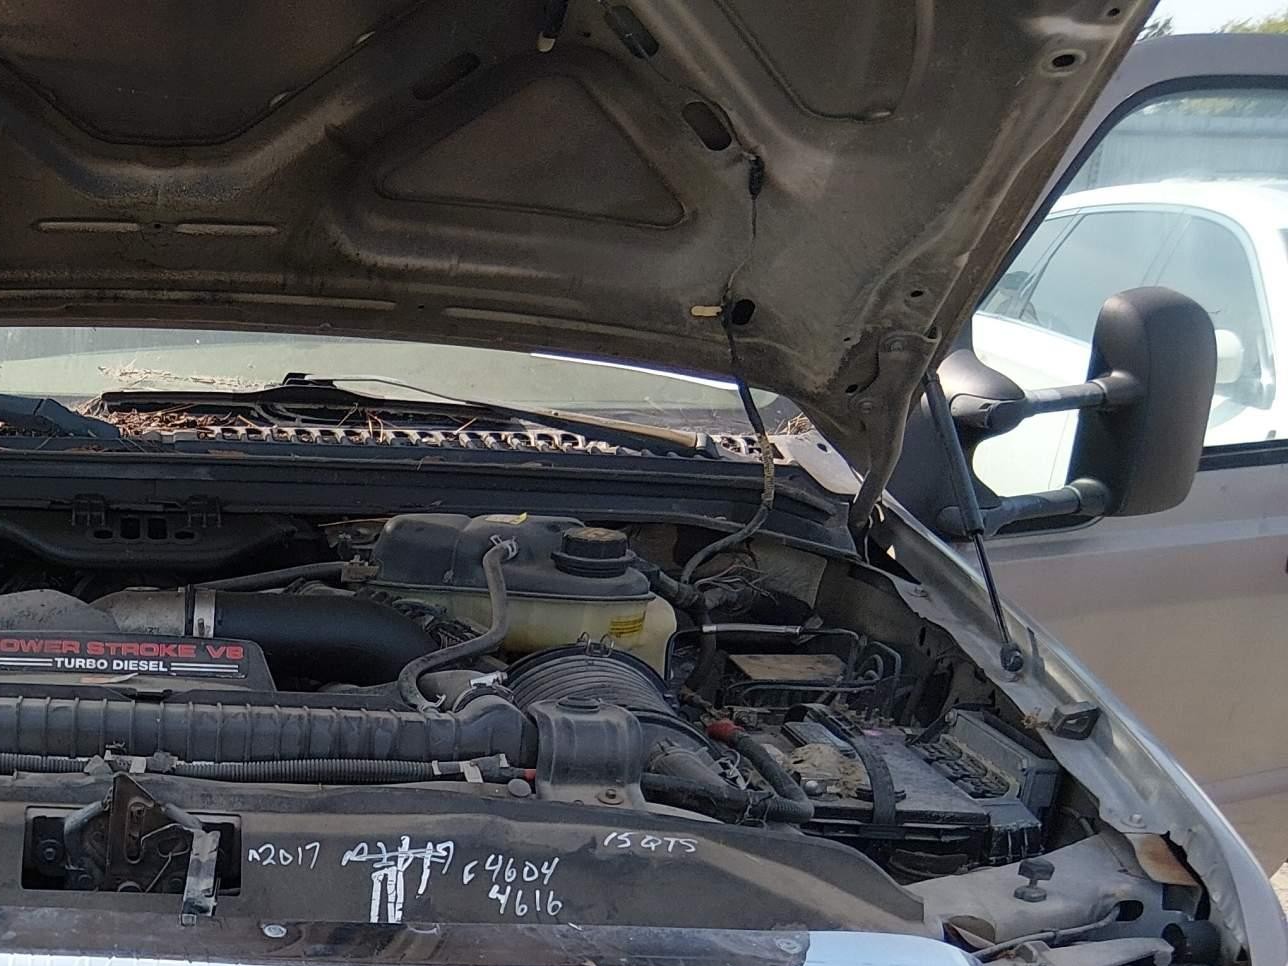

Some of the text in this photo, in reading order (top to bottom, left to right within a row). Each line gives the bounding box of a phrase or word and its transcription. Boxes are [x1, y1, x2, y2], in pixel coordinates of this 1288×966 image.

[86, 641, 197, 657] STROKE
[206, 645, 244, 660] V8
[54, 657, 169, 672] TURBO DIESEL
[488, 883, 563, 917] 4616
